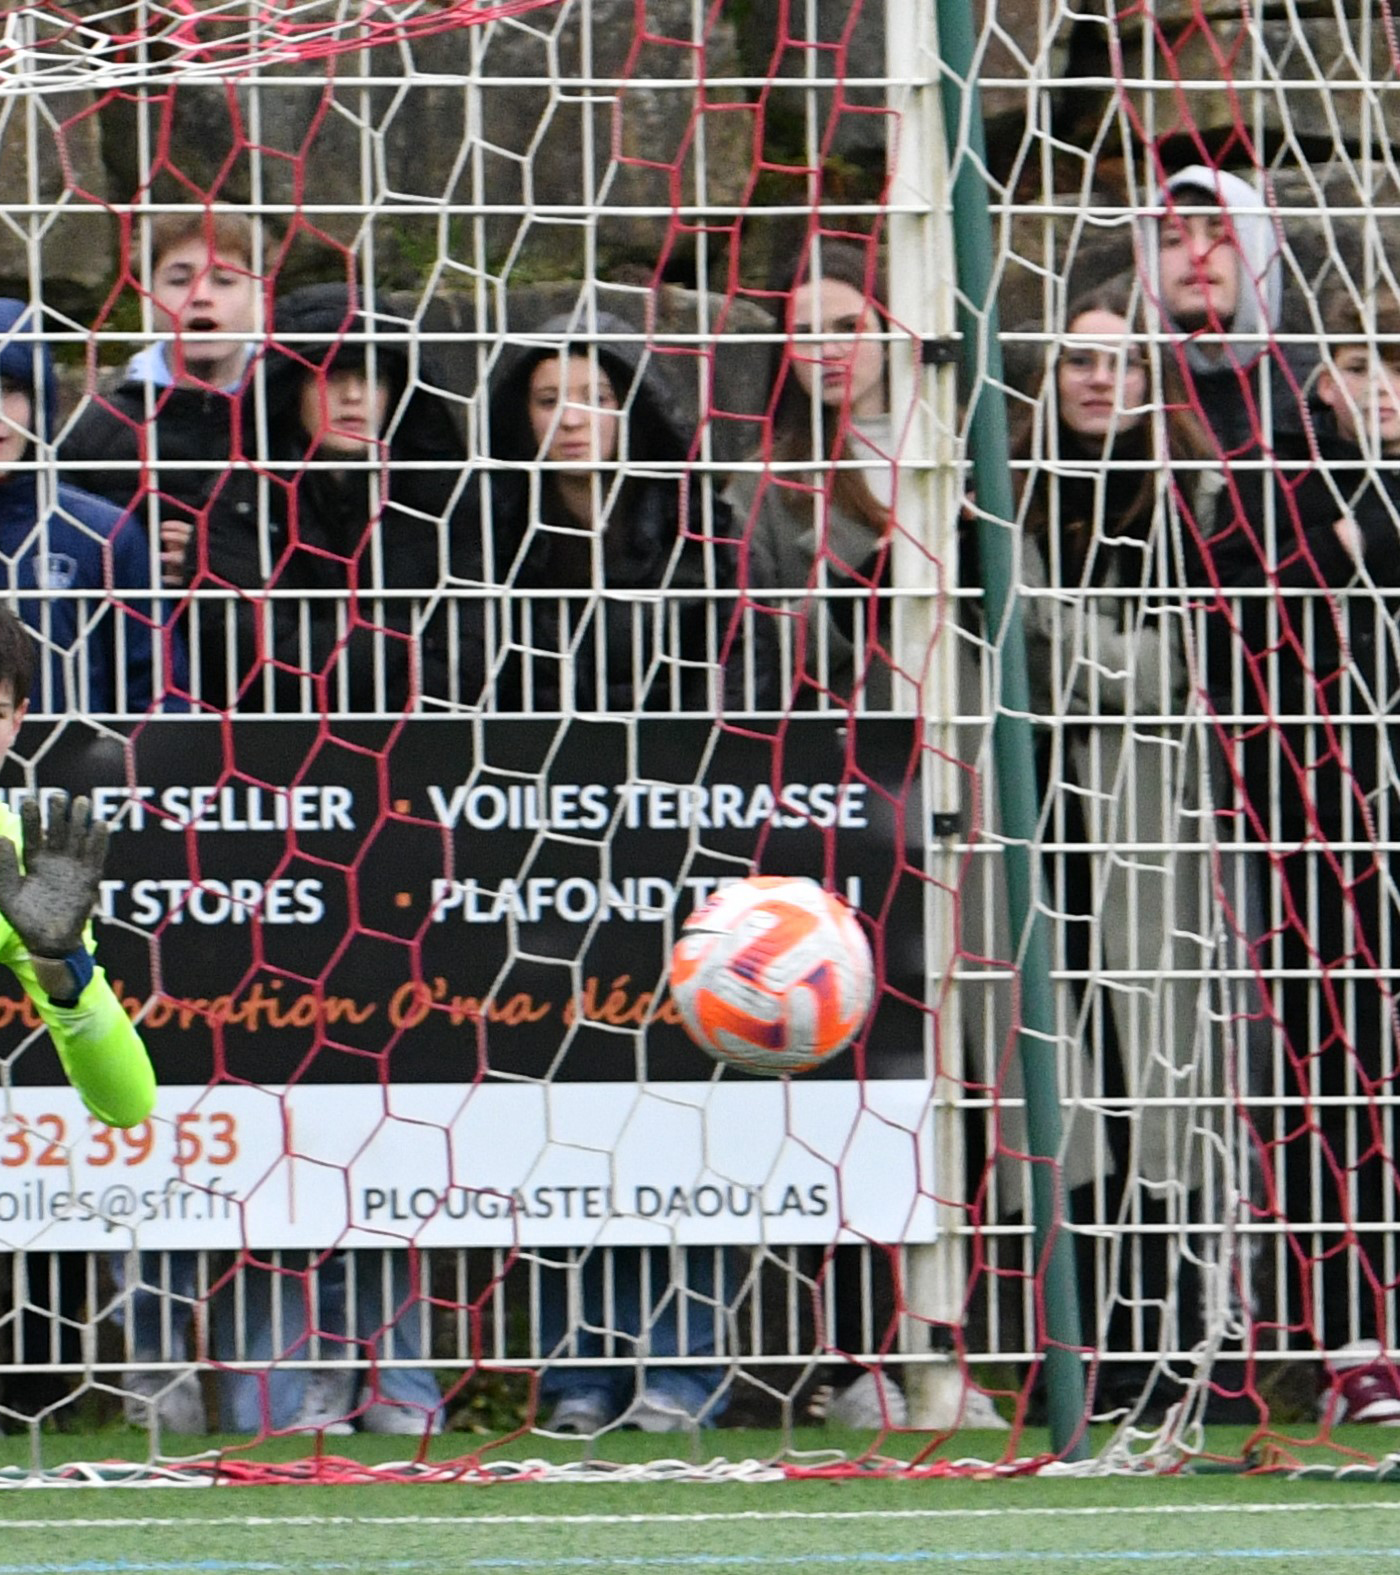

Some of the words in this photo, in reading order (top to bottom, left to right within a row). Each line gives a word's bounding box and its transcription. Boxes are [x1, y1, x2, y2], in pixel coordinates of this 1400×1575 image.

[92, 786, 155, 830] ET
[160, 785, 354, 831] SELLIER
[428, 785, 606, 829] VOILES
[616, 784, 868, 828] TERRASSE
[131, 879, 325, 925] STORES
[431, 878, 675, 923] PLAFOND
[1, 1113, 69, 1167] 32
[86, 1114, 153, 1167] 39
[173, 1112, 239, 1166] 53
[364, 1186, 624, 1220] PLOUGASTEL
[636, 1184, 828, 1217] DAOULAS
